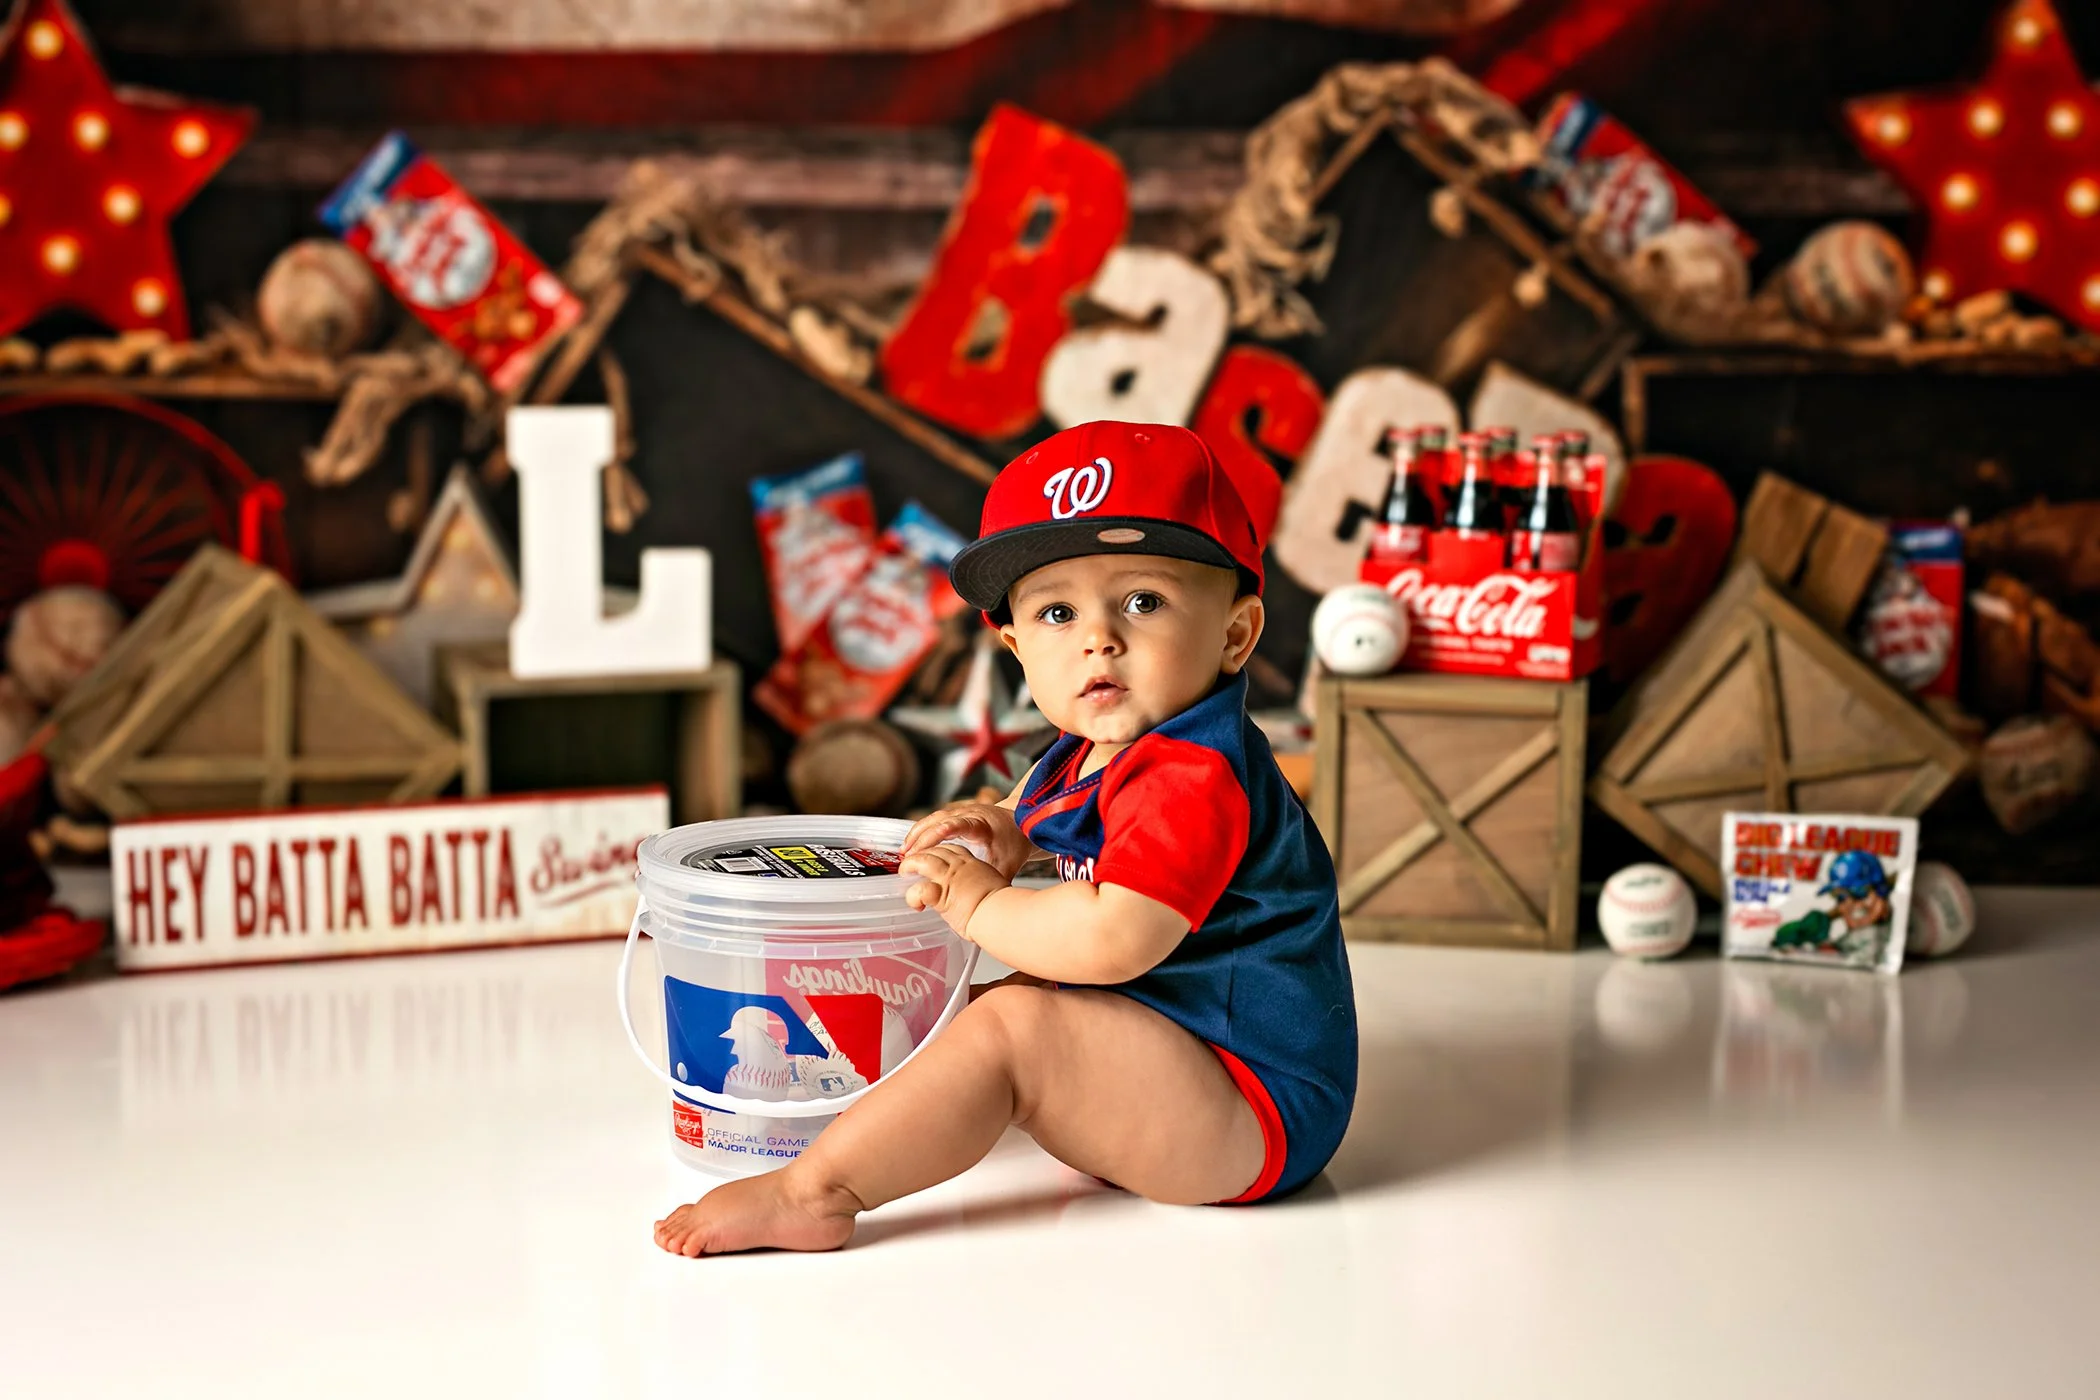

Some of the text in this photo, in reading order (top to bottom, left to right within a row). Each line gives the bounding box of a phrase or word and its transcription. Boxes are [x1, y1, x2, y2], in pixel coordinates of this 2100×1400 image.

[1043, 456, 1113, 520] W
[505, 405, 712, 681] L
[1789, 824, 1901, 858] LEAGUE
[1734, 852, 1823, 880] CHEW
[127, 845, 209, 946] HEY
[231, 835, 371, 939] BATTA
[388, 825, 521, 927] BATTA
[707, 1127, 761, 1144] OFFICIAL
[766, 1136, 809, 1148] GAME
[707, 1139, 747, 1154] MAJOR
[751, 1146, 802, 1158] LEAGUE
